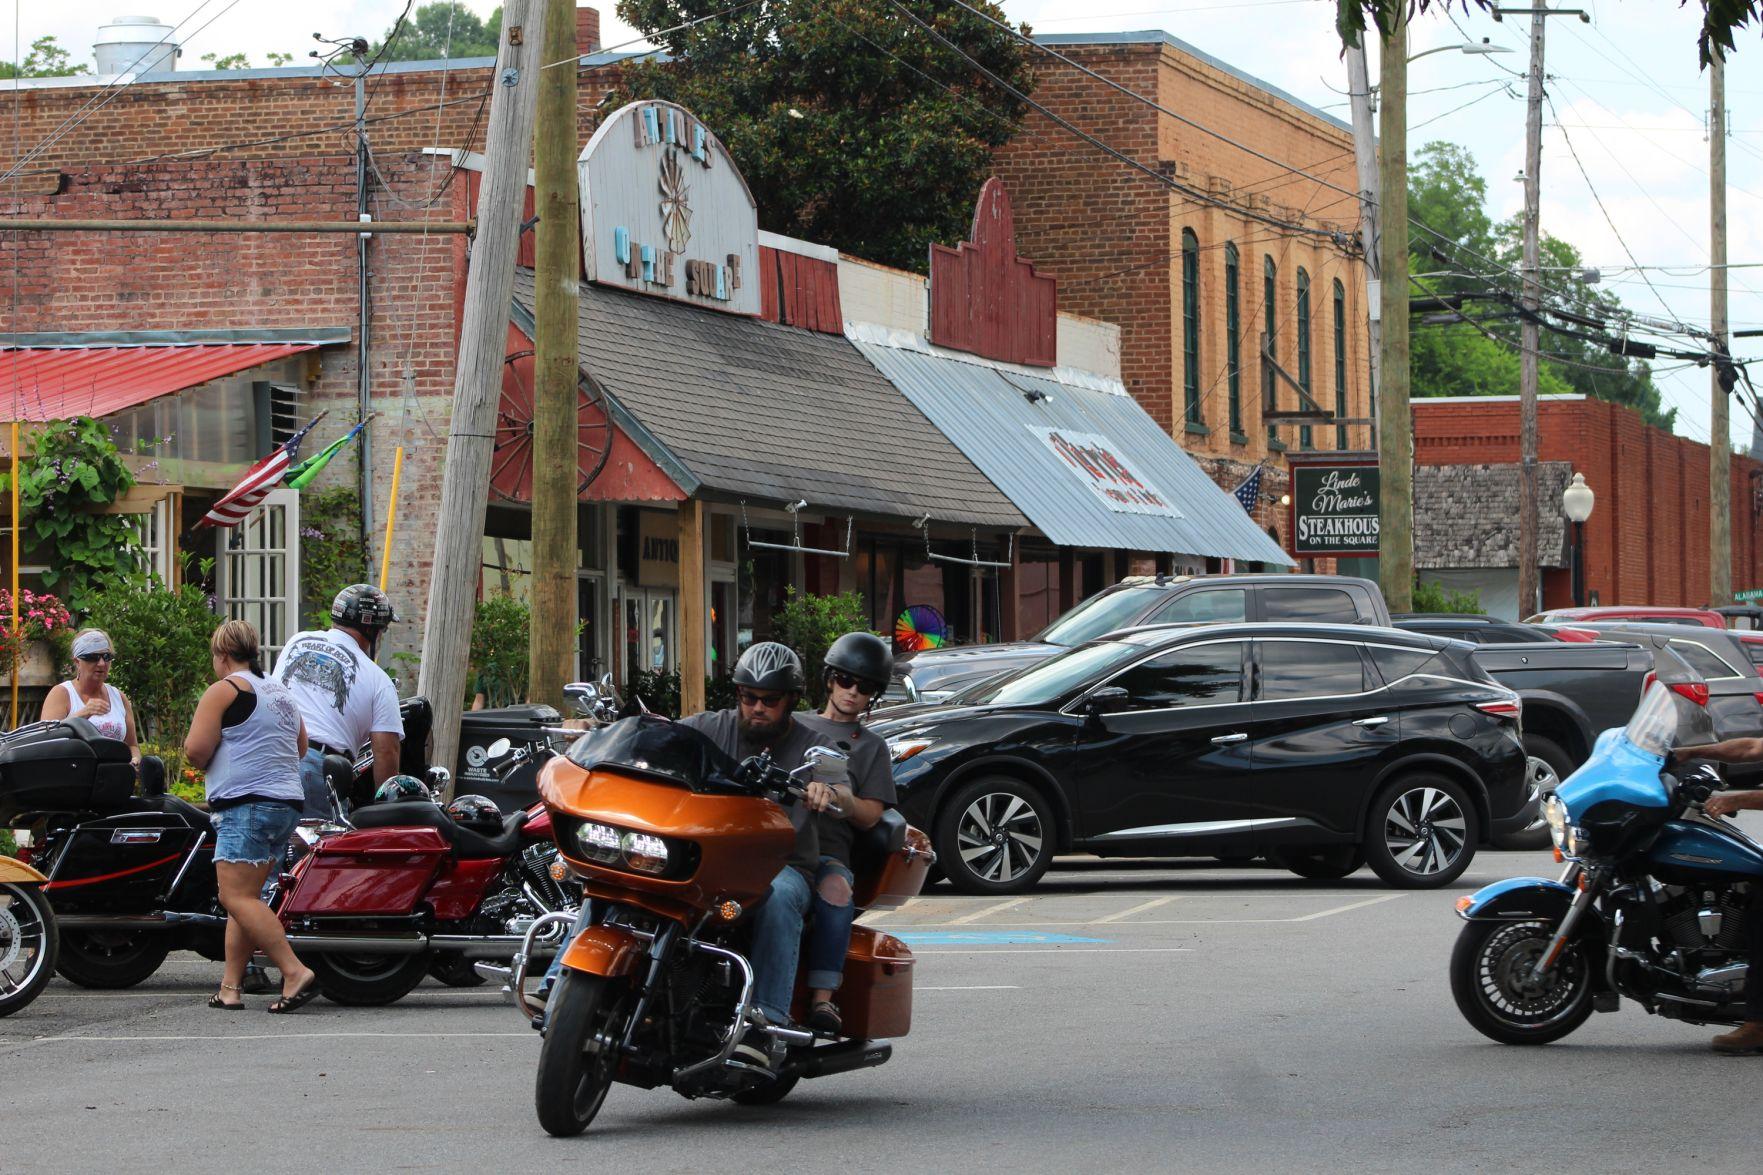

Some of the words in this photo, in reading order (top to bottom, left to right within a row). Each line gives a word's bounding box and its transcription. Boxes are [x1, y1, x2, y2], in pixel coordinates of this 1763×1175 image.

[633, 107, 713, 169] ANTIQUES
[615, 226, 641, 279] ON
[640, 245, 675, 287] THE
[685, 254, 741, 301] SQUARE
[1317, 470, 1361, 494] Linde
[1312, 490, 1373, 513] Marie's
[1299, 515, 1380, 540] STEAKHOUS
[1309, 536, 1321, 544] ON
[1324, 536, 1341, 544] THE
[1343, 535, 1378, 545] SQUARE
[643, 536, 680, 563] ANTIQ
